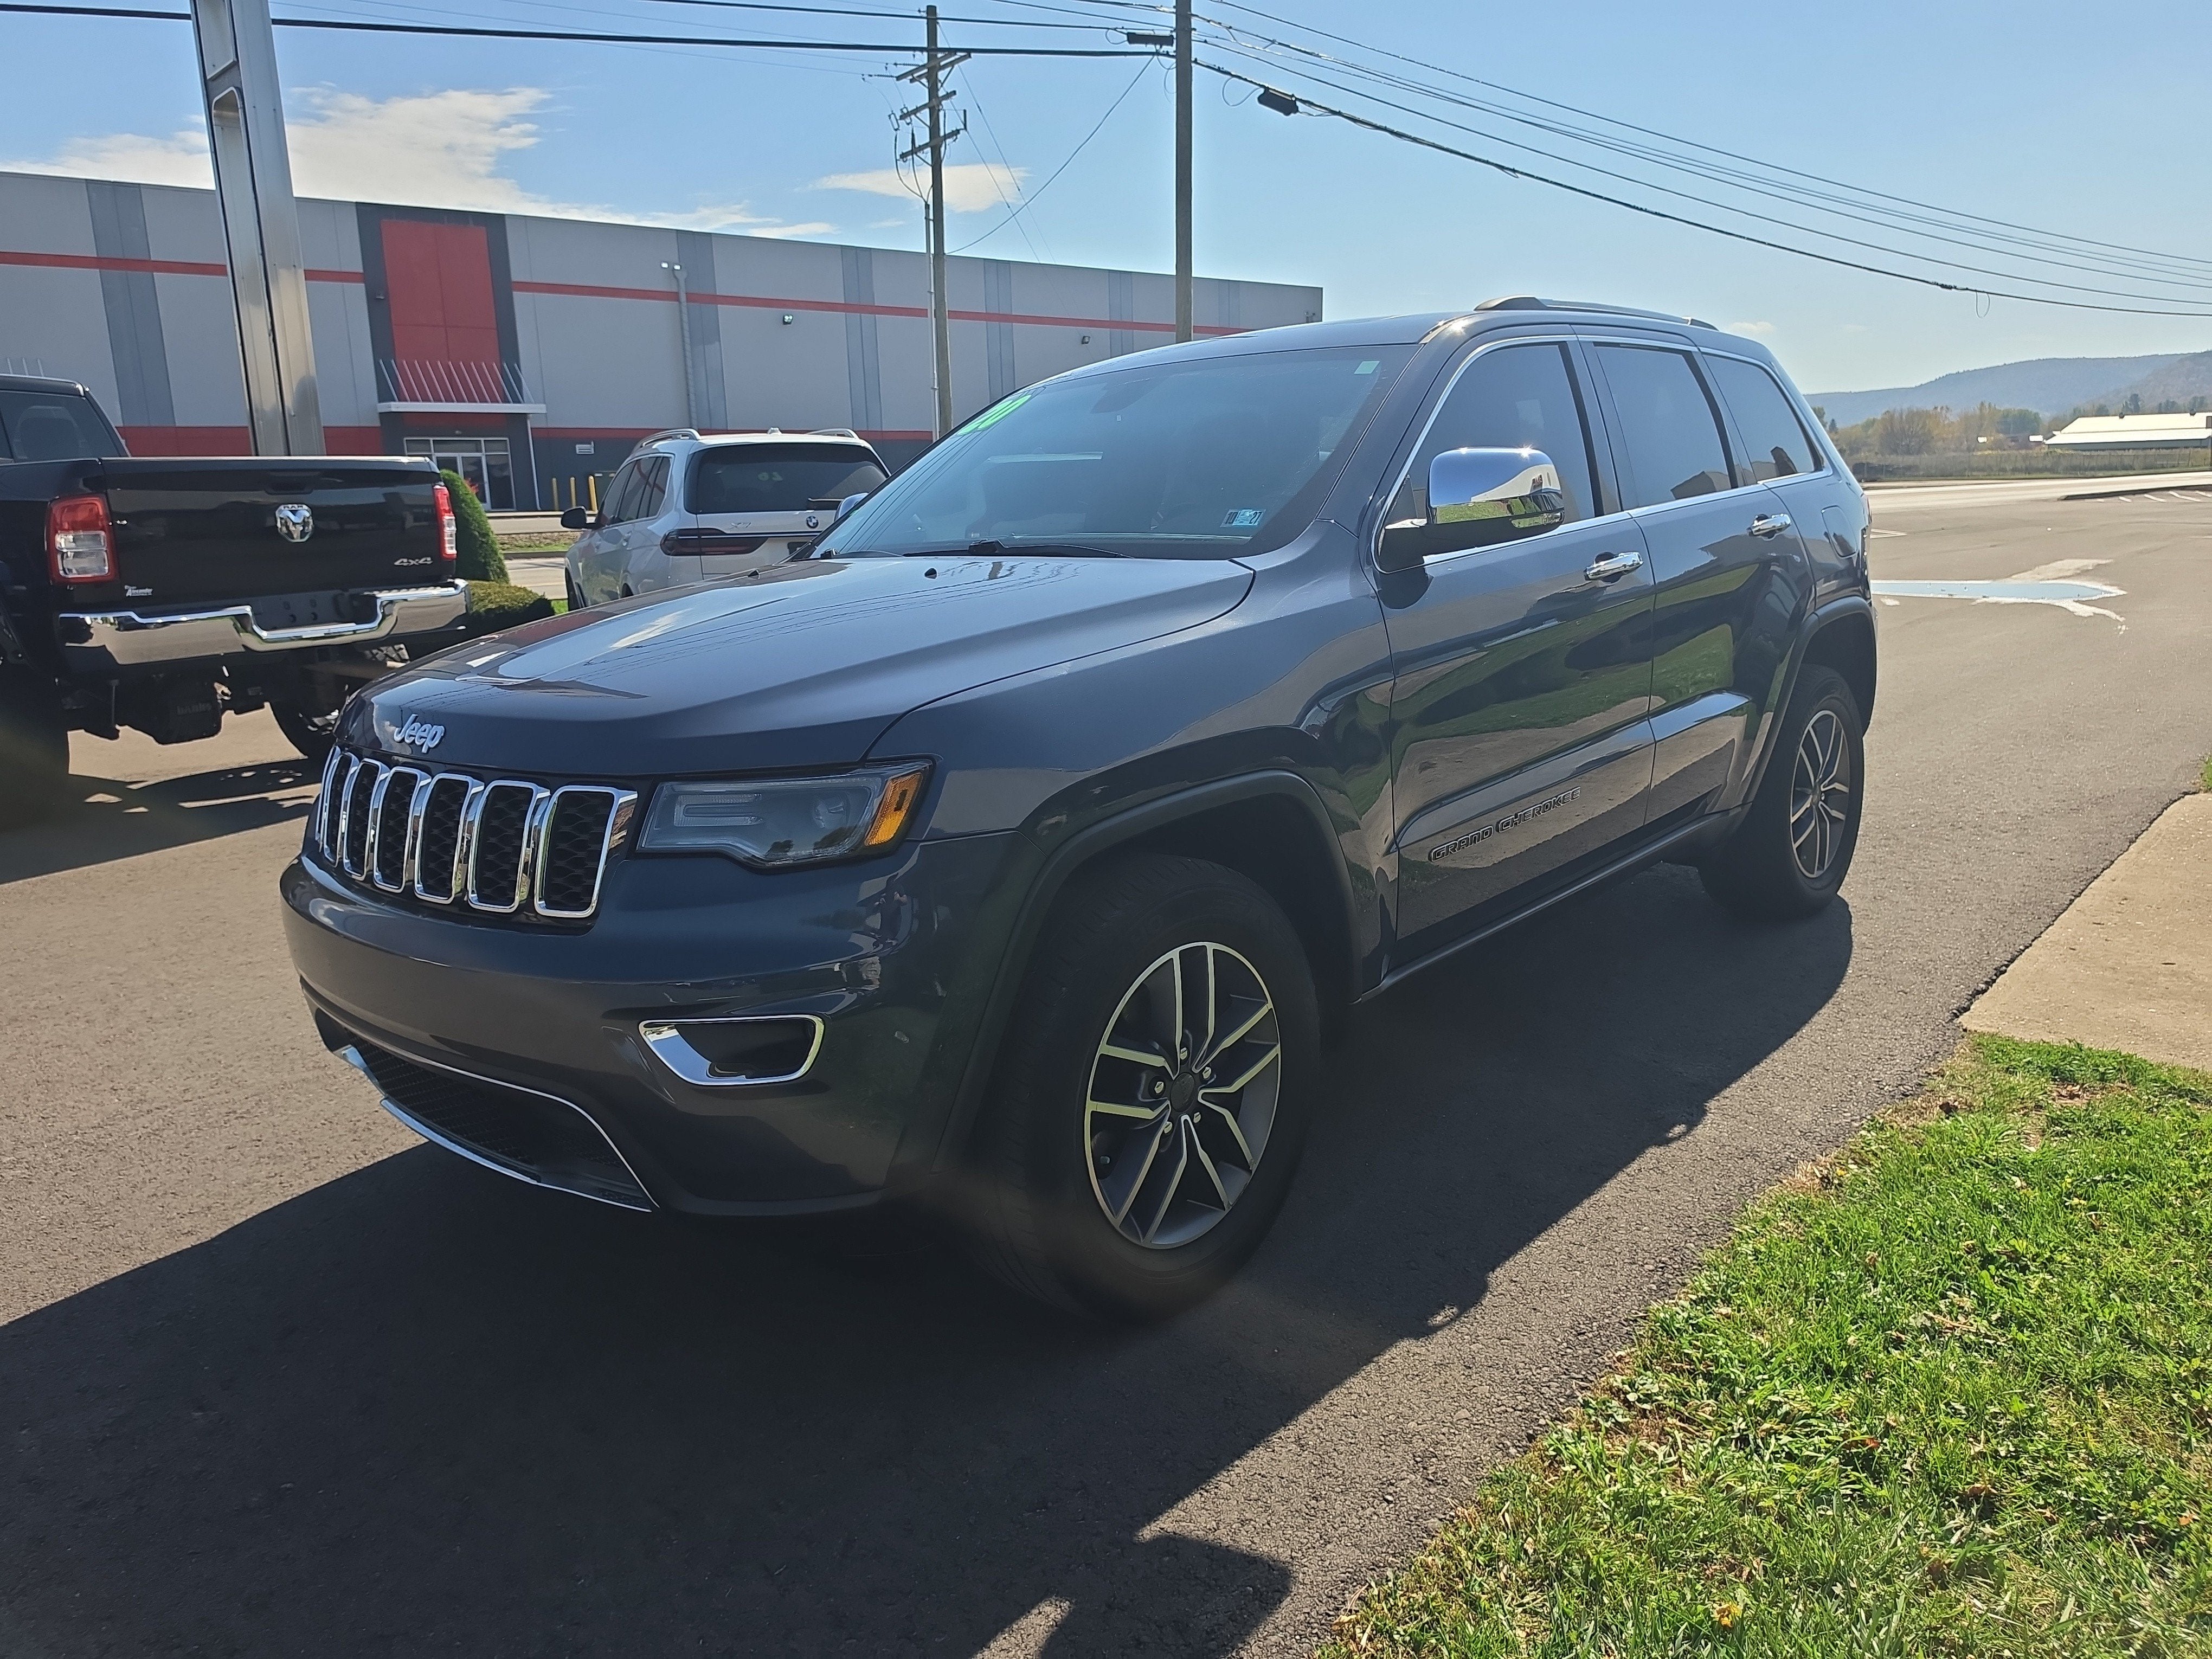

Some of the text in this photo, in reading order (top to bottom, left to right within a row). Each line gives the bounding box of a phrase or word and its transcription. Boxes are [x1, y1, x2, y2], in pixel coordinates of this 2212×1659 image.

[1249, 511, 1263, 525] 27
[394, 557, 433, 566] 4x4
[394, 713, 445, 754] Jeep
[1428, 787, 1581, 862] GRAND CHEROKEE
